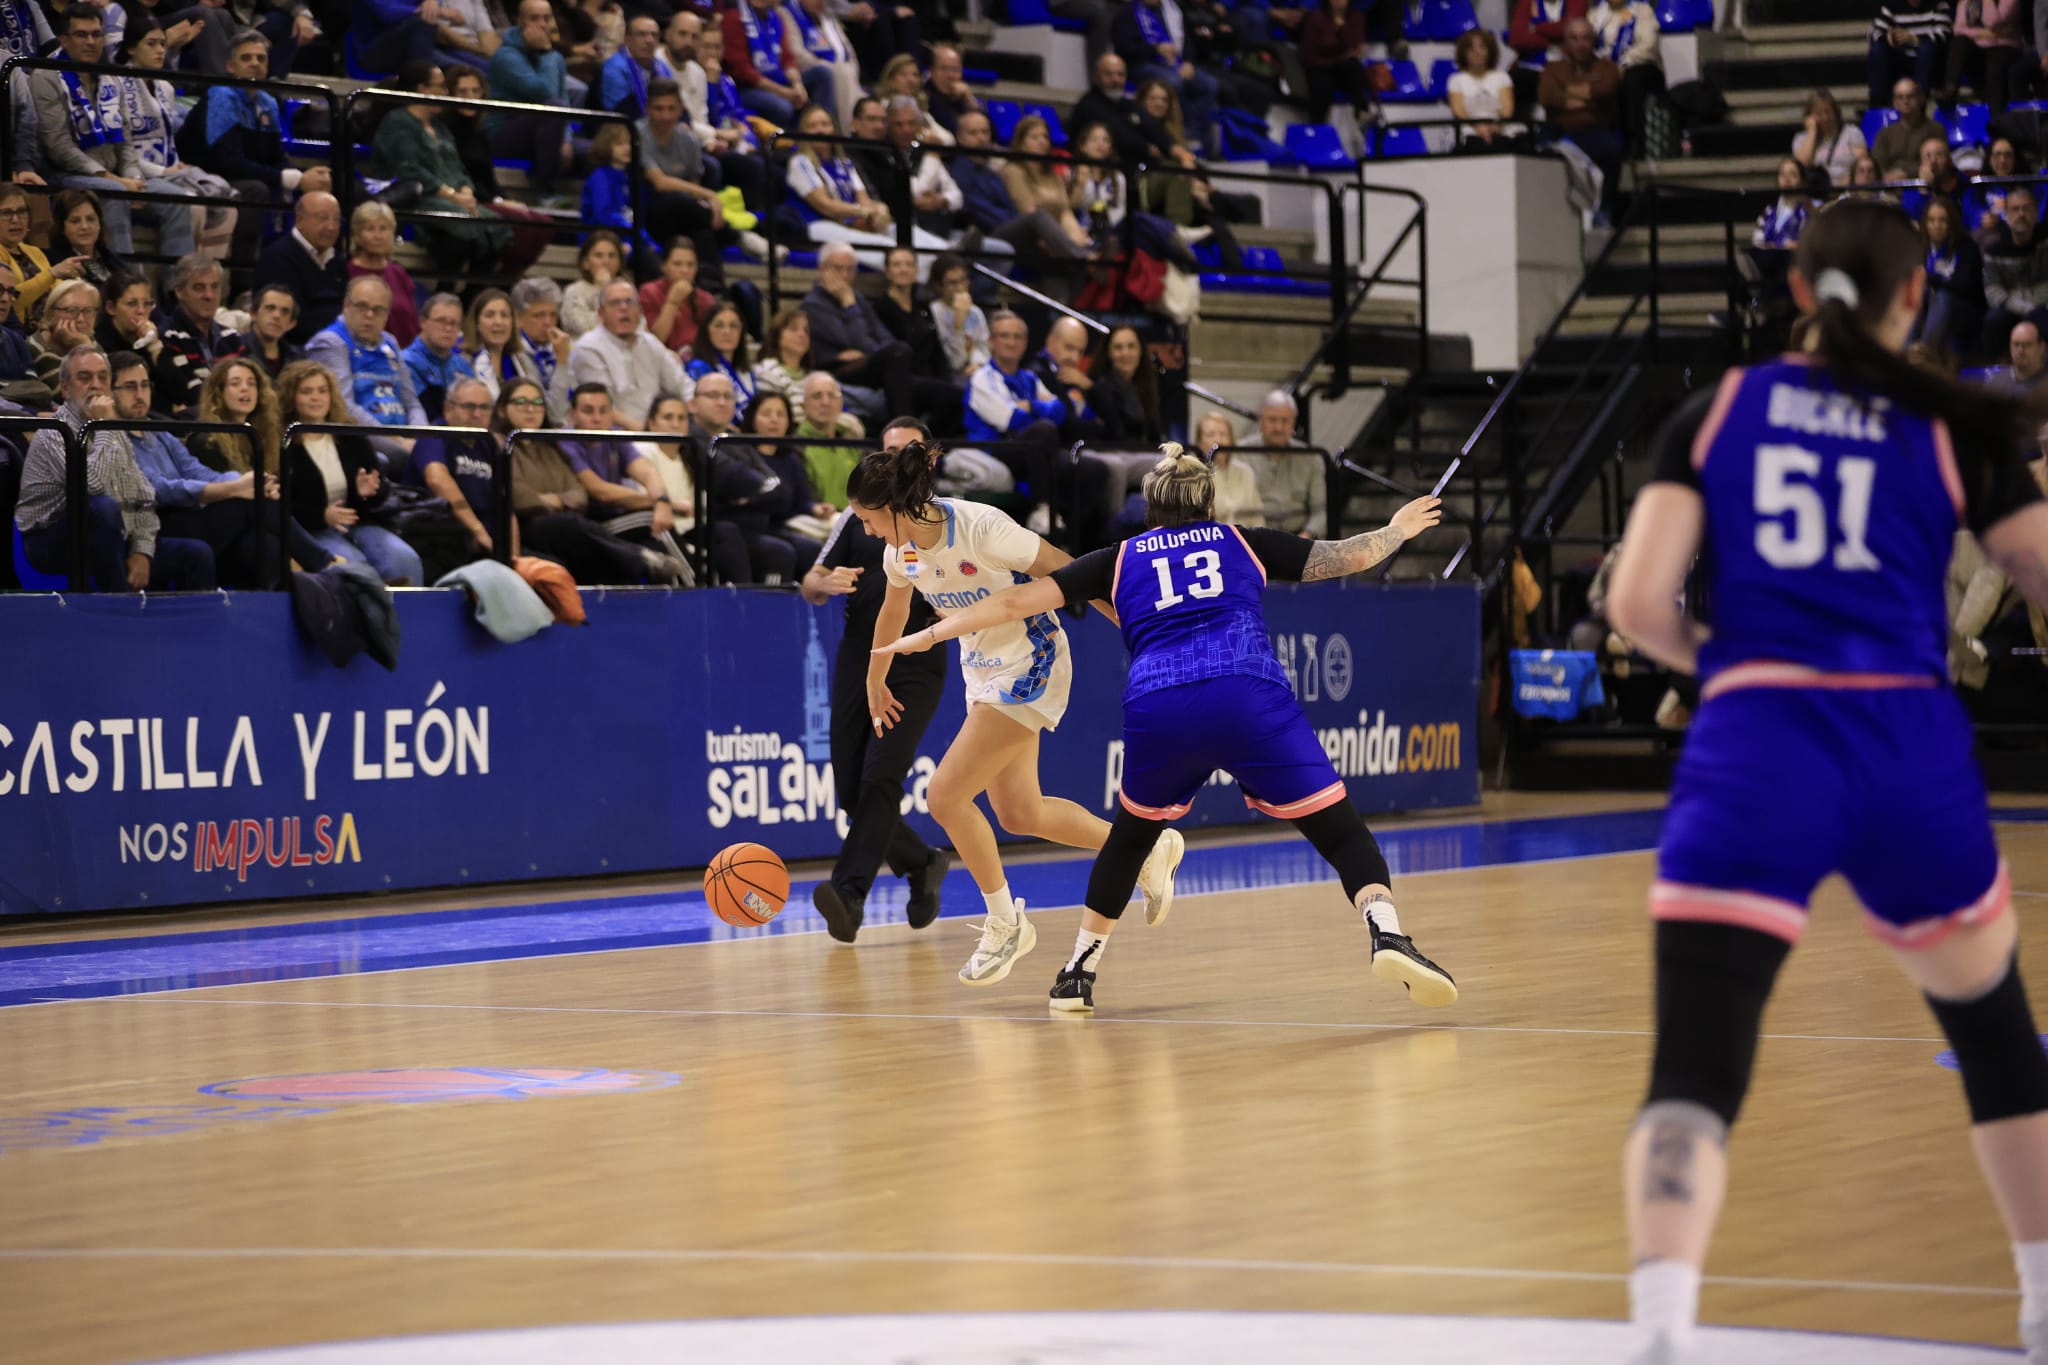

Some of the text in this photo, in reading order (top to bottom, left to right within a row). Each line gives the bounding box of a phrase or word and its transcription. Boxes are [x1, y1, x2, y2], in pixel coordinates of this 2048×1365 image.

[1754, 443, 1881, 571] 51
[1152, 549, 1225, 611] 13
[293, 712, 331, 800] Y
[353, 681, 489, 780] LEÓN
[706, 725, 781, 763] turismo
[120, 812, 362, 882] NOS IMPULSA
